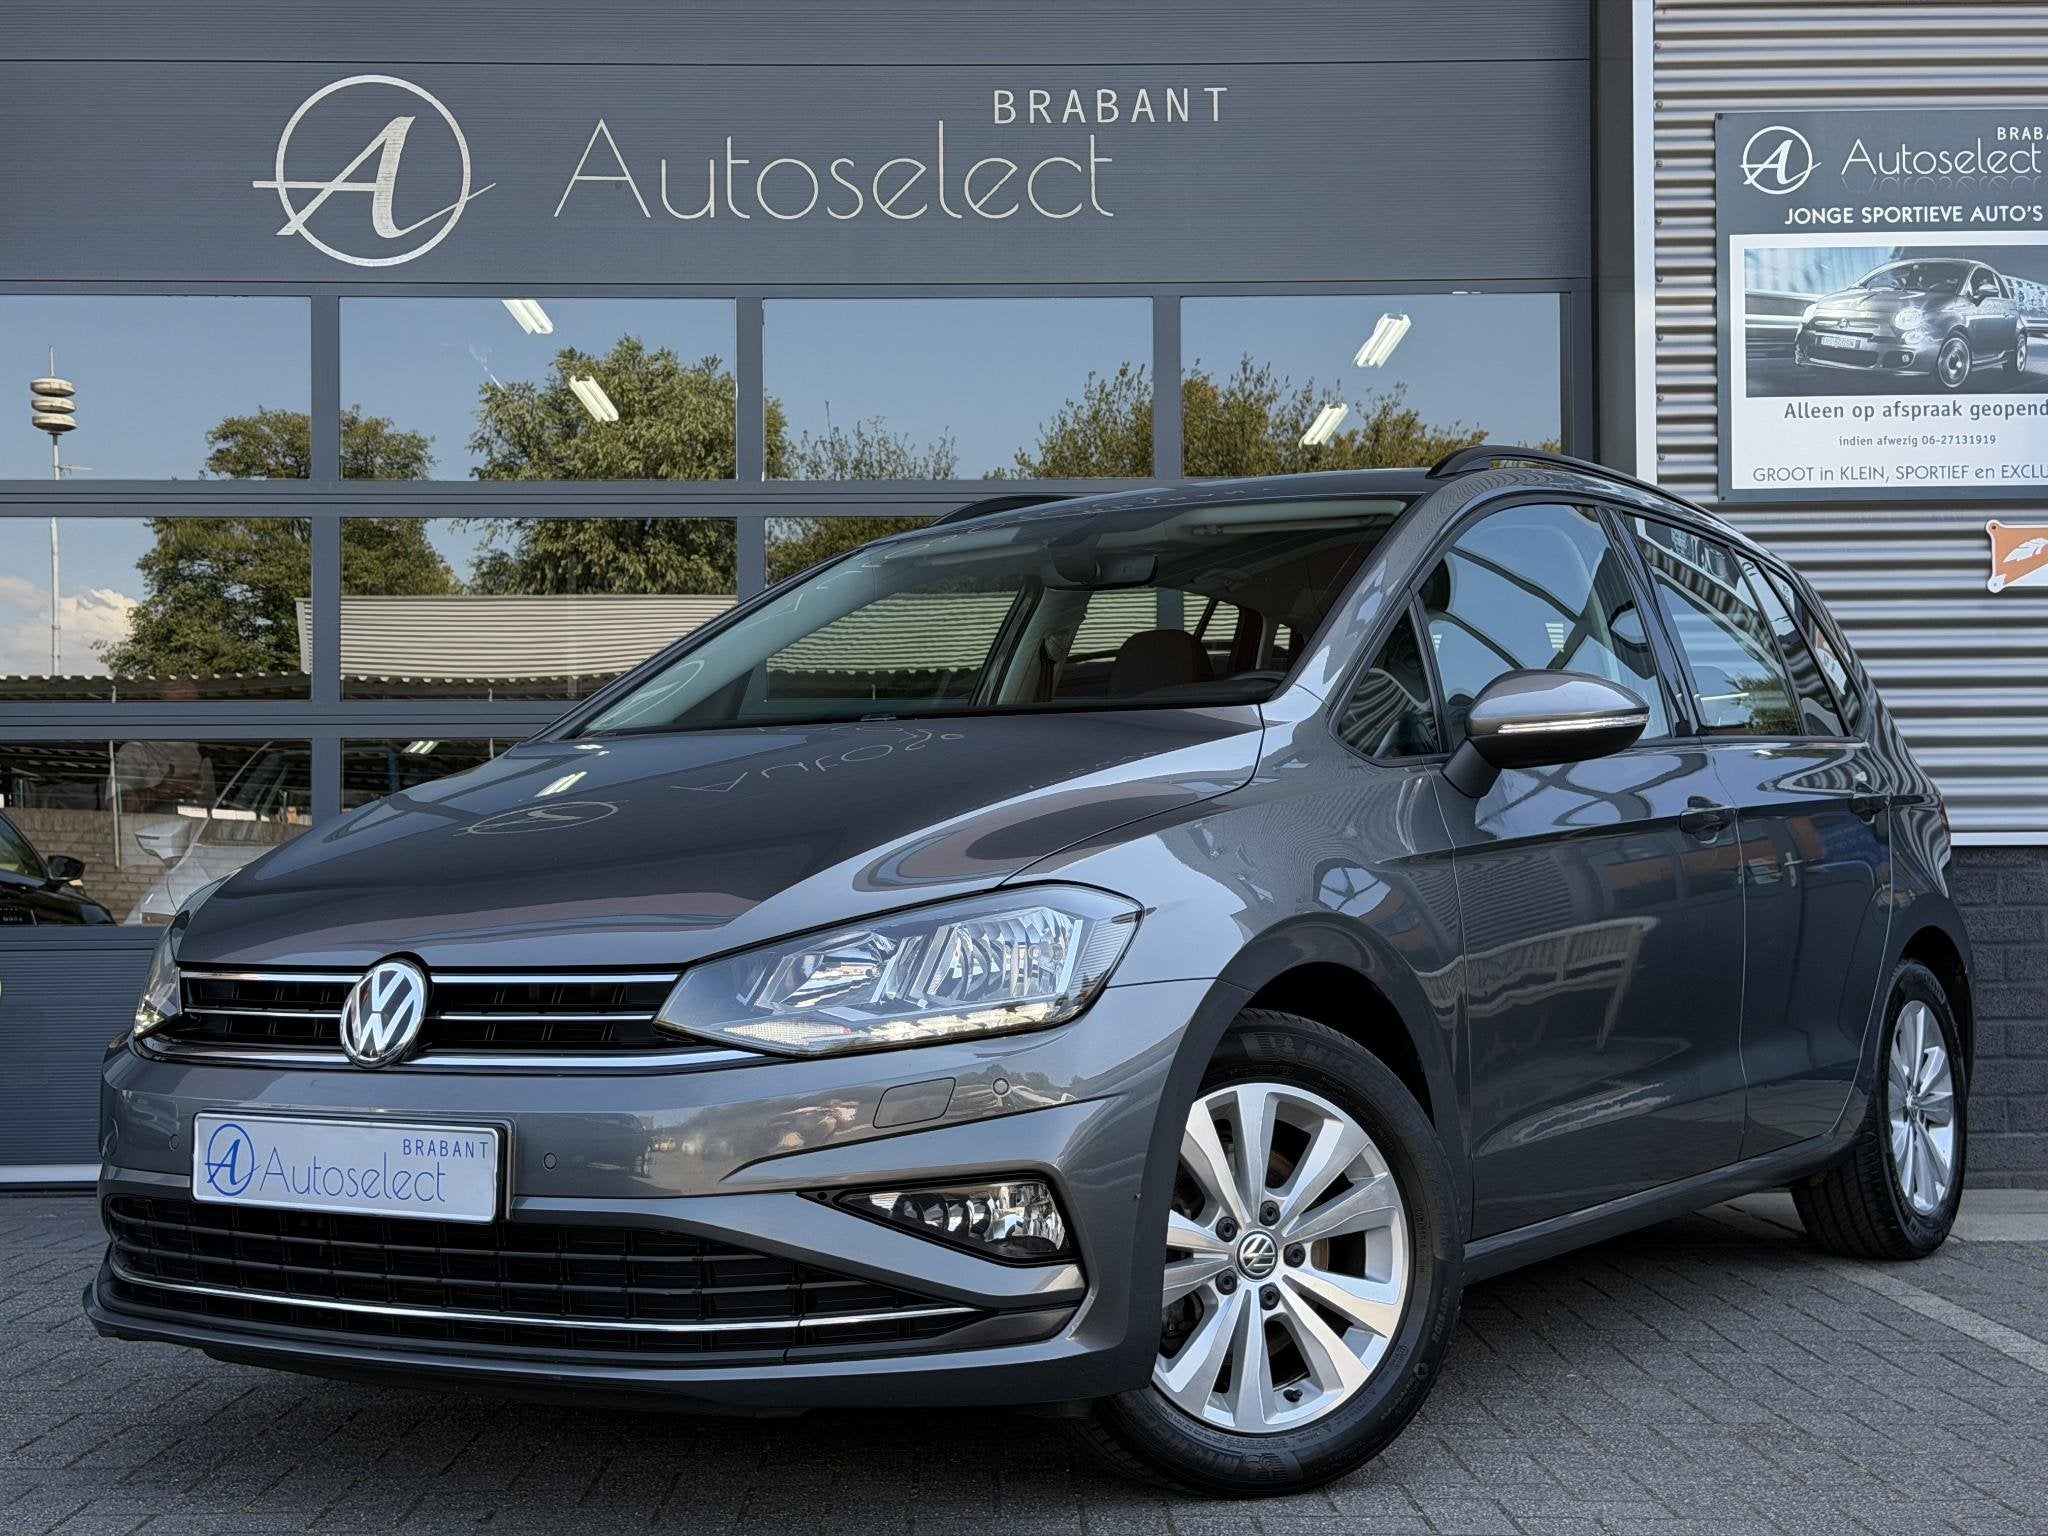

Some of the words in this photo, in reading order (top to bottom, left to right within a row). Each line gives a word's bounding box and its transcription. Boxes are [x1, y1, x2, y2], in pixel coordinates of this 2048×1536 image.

[995, 87, 1228, 123] BRABANT
[1997, 126, 2048, 141] BRAB
[1841, 137, 2042, 175] Autoselect
[553, 118, 1114, 219] Autoselect
[1784, 207, 1854, 225] JONGE
[1861, 206, 1963, 224] SPORTIEVE
[1969, 205, 2044, 222] AUTO'S
[1784, 402, 1844, 419] Alleen
[1852, 405, 1875, 422] op
[1882, 400, 1963, 422] afspraak
[1969, 399, 2048, 421] geopend
[1838, 435, 1873, 446] indien
[1876, 435, 1918, 448] afwezig
[1921, 434, 1997, 445] 06-27131919
[1752, 467, 1814, 482] GROOT
[1820, 466, 1834, 481] in
[1840, 466, 1889, 483] KLEIN,
[1896, 465, 1970, 480] SPORTIEF
[1974, 467, 1995, 479] en
[402, 1138, 489, 1159] BRABANT
[259, 1146, 446, 1202] Autoselect
